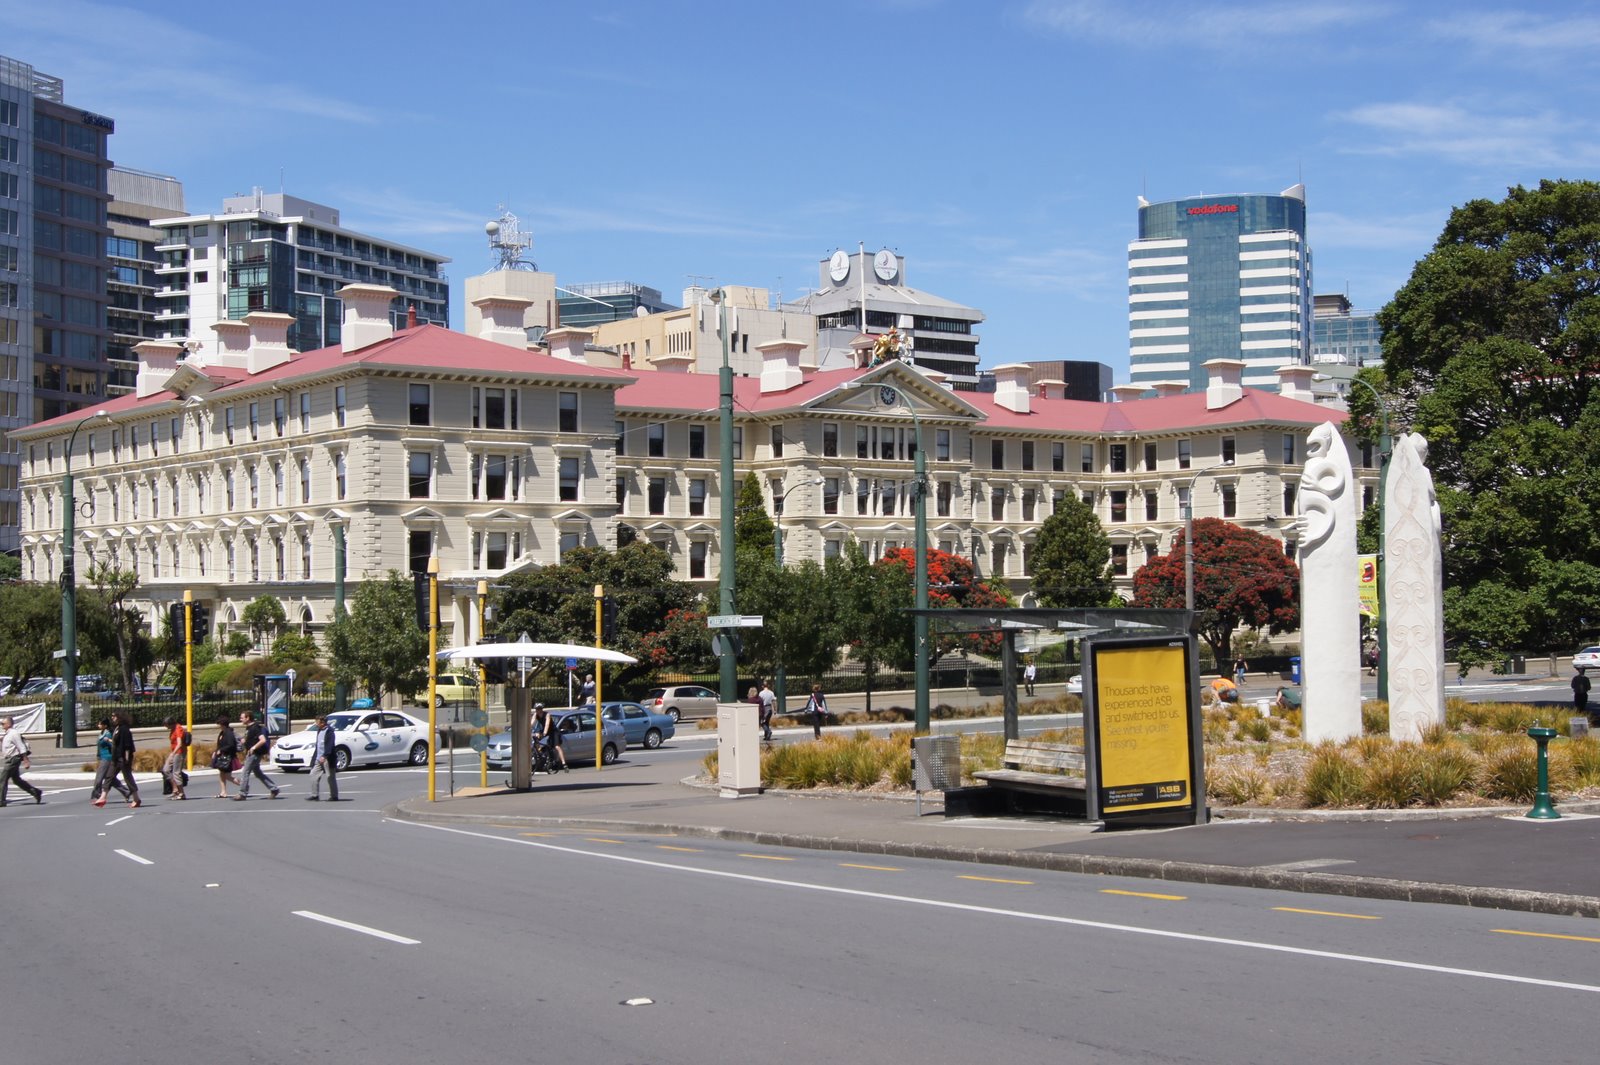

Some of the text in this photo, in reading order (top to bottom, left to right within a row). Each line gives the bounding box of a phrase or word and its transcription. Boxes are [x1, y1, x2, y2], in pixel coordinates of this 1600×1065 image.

[1187, 204, 1238, 215] vodafone
[1104, 684, 1169, 697] Thousands have
[1104, 696, 1172, 710] experienced ASB
[1105, 710, 1180, 723] and switched to us.
[1106, 725, 1121, 736] See
[1123, 724, 1143, 735] what
[1159, 785, 1181, 794] ASB
